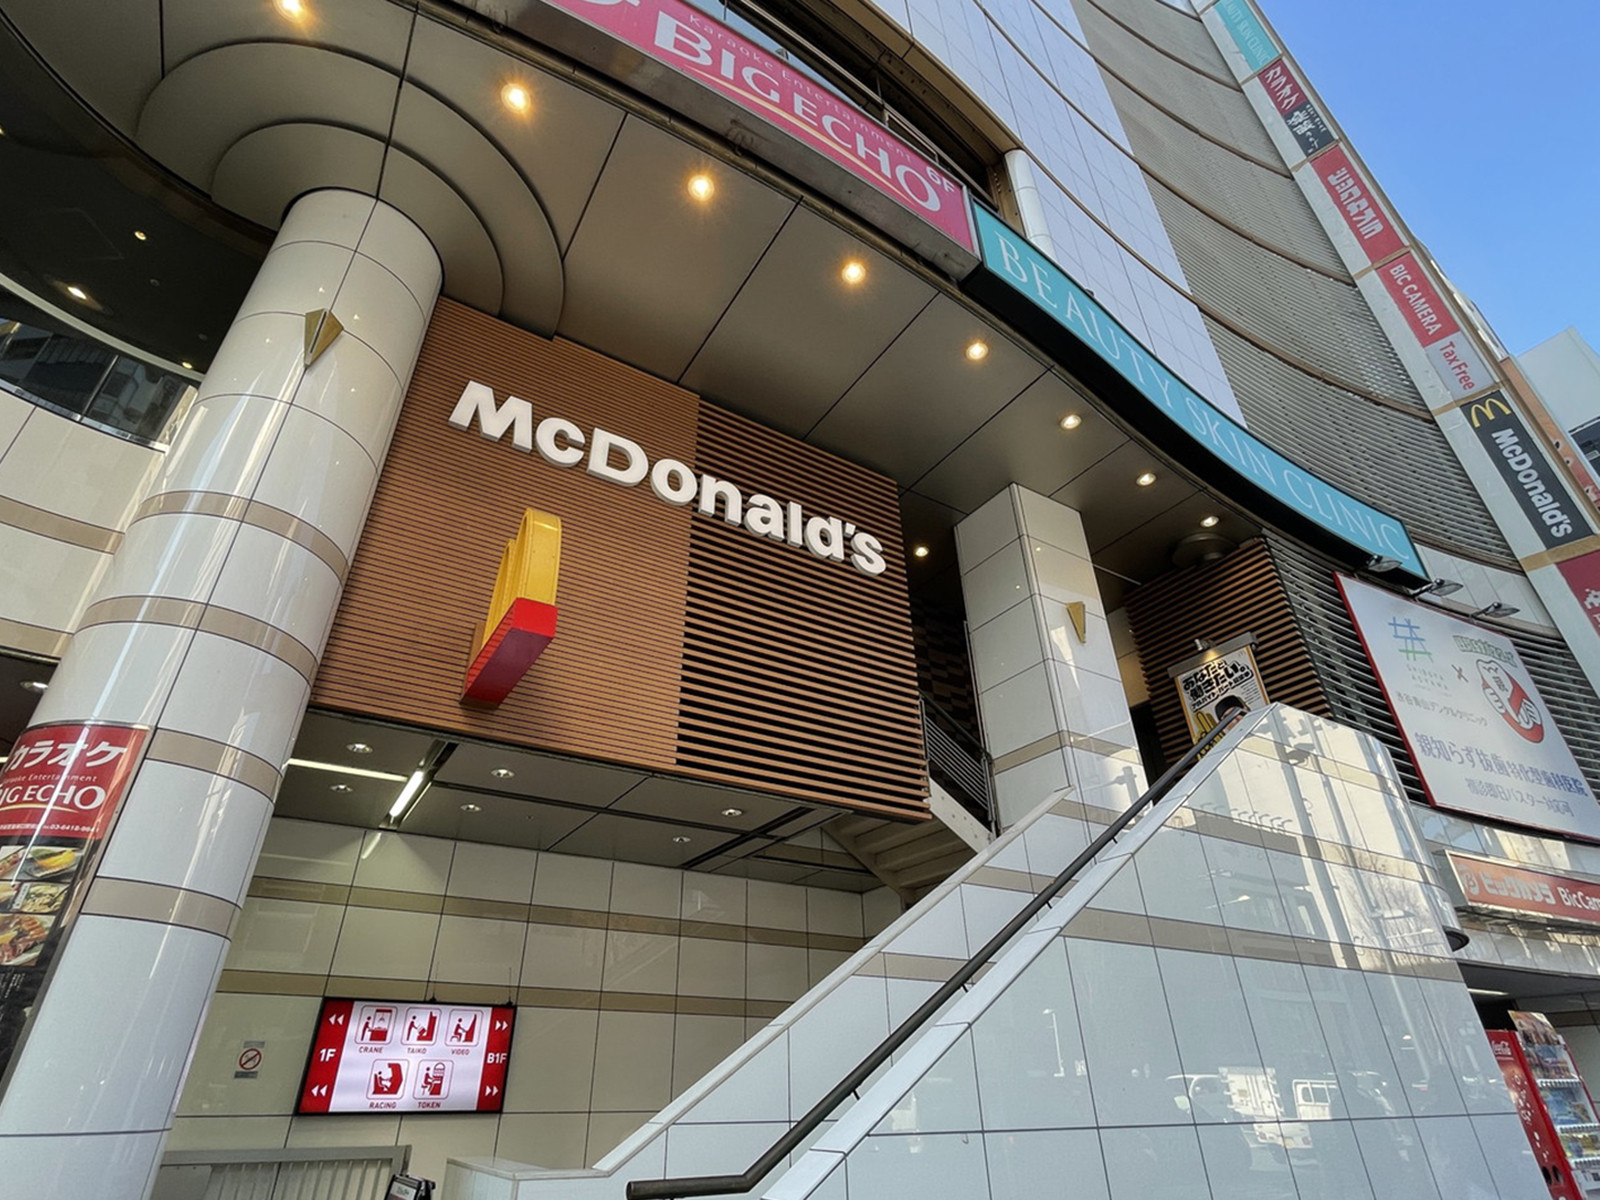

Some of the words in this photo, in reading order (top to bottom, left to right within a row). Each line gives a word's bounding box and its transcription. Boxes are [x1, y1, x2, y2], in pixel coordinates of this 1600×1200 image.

[689, 14, 775, 71] Karaoke
[781, 69, 914, 163] Entertainment
[654, 11, 781, 104] BIG
[793, 95, 941, 212] ECHO
[925, 166, 956, 194] 6F
[1389, 264, 1406, 286] BIC
[1402, 278, 1442, 336] CAMERA
[1439, 341, 1460, 366] Tax
[1451, 360, 1475, 391] Free
[993, 229, 1175, 411] BEAUTY
[1184, 395, 1277, 487] SKIN
[1282, 468, 1410, 562] CLINIC
[448, 380, 887, 577] McDonald's
[1491, 428, 1572, 539] McDonald's
[5, 740, 128, 773] カラオケ
[28, 773, 98, 782] Entertament
[0, 786, 23, 804] IG
[22, 784, 107, 810] ECHO
[319, 1048, 337, 1062] 1F
[358, 1046, 383, 1054] CRANE
[407, 1047, 427, 1055] TAIKO
[450, 1048, 470, 1056] VIDEO
[486, 1053, 508, 1064] B1F
[369, 1101, 397, 1110] RACING
[417, 1101, 441, 1109] TOKEN
